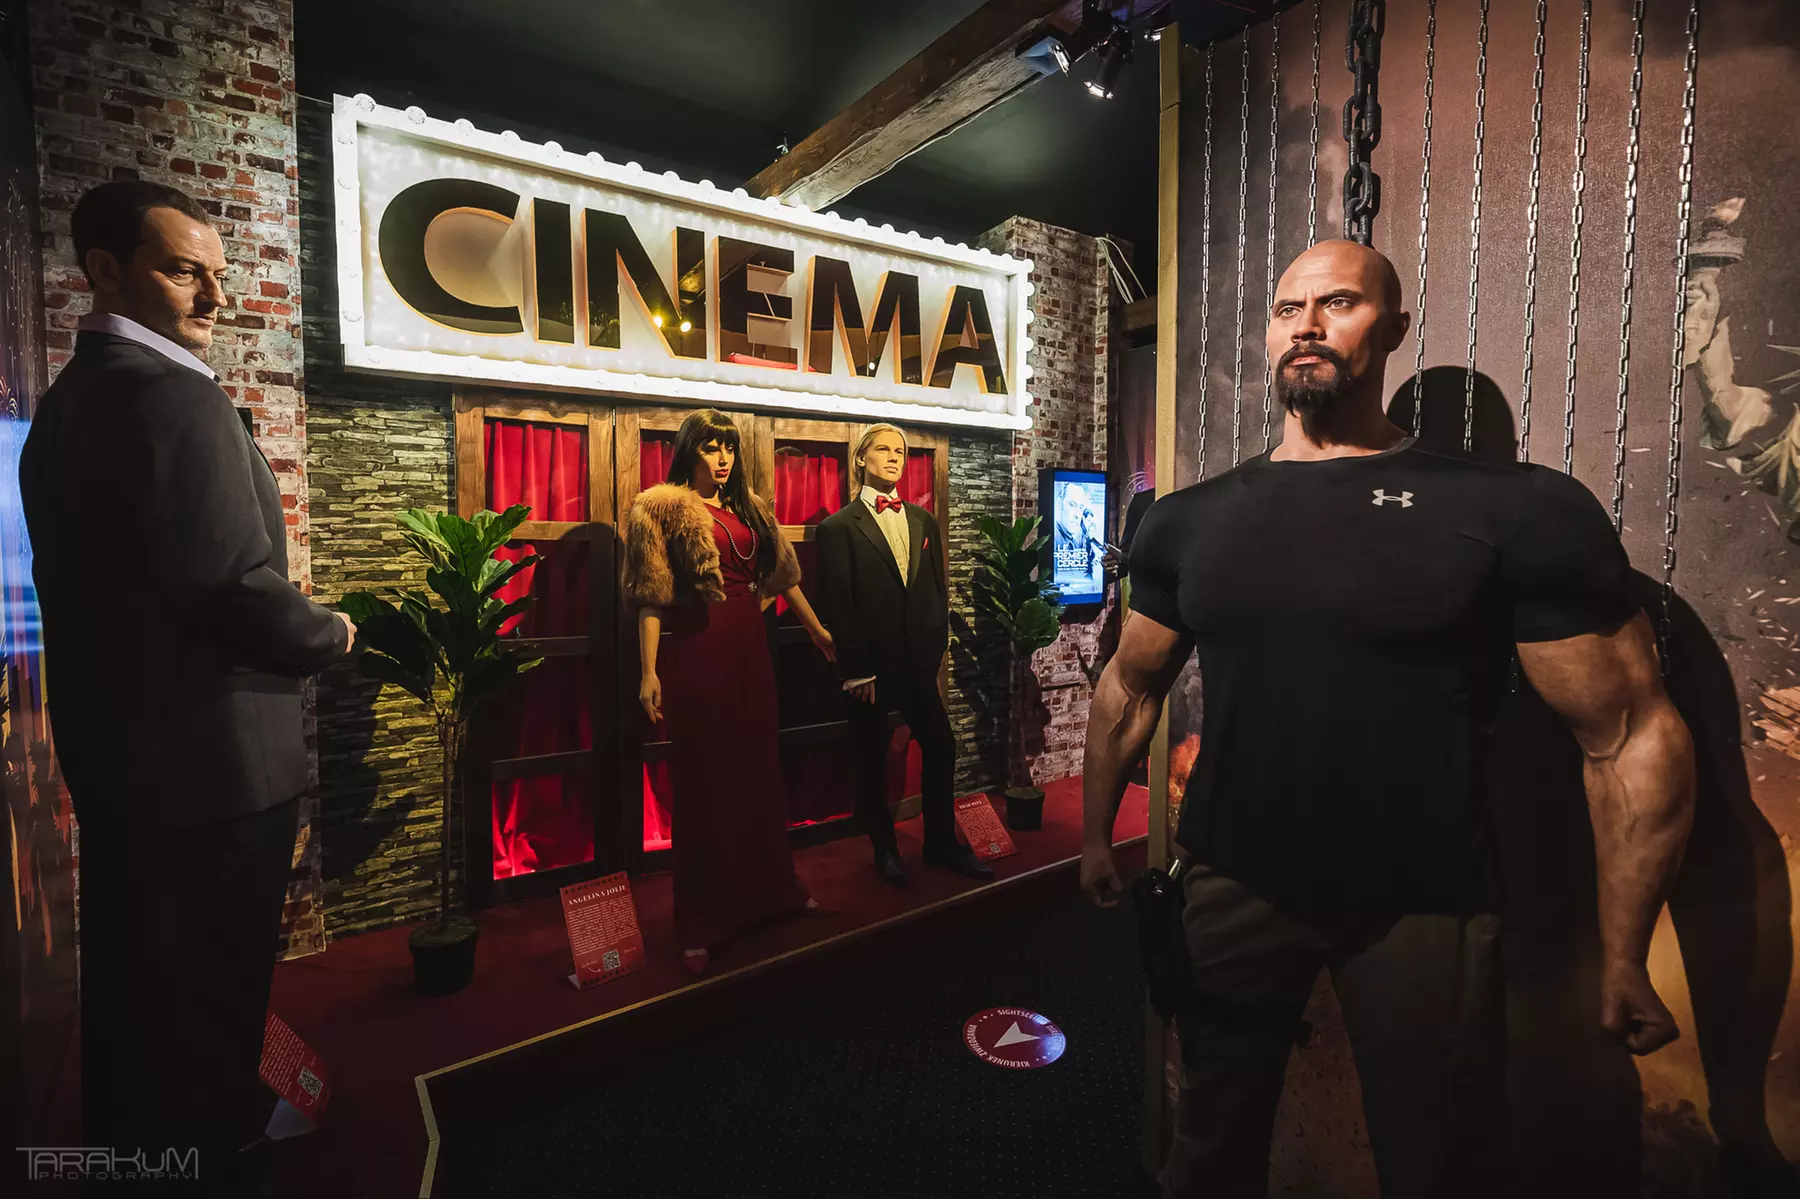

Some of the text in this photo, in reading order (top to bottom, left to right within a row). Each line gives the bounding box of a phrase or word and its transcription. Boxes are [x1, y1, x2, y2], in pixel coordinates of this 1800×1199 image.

[379, 178, 1009, 395] CINEMA
[1057, 543, 1069, 552] LE
[1054, 551, 1088, 560] PREMIER
[1057, 559, 1088, 567] CERCLE
[568, 884, 626, 905] ANGELINA JOLIE
[997, 1009, 1046, 1025] SIGHTSEEI
[986, 1054, 1031, 1068] KIERUNEK
